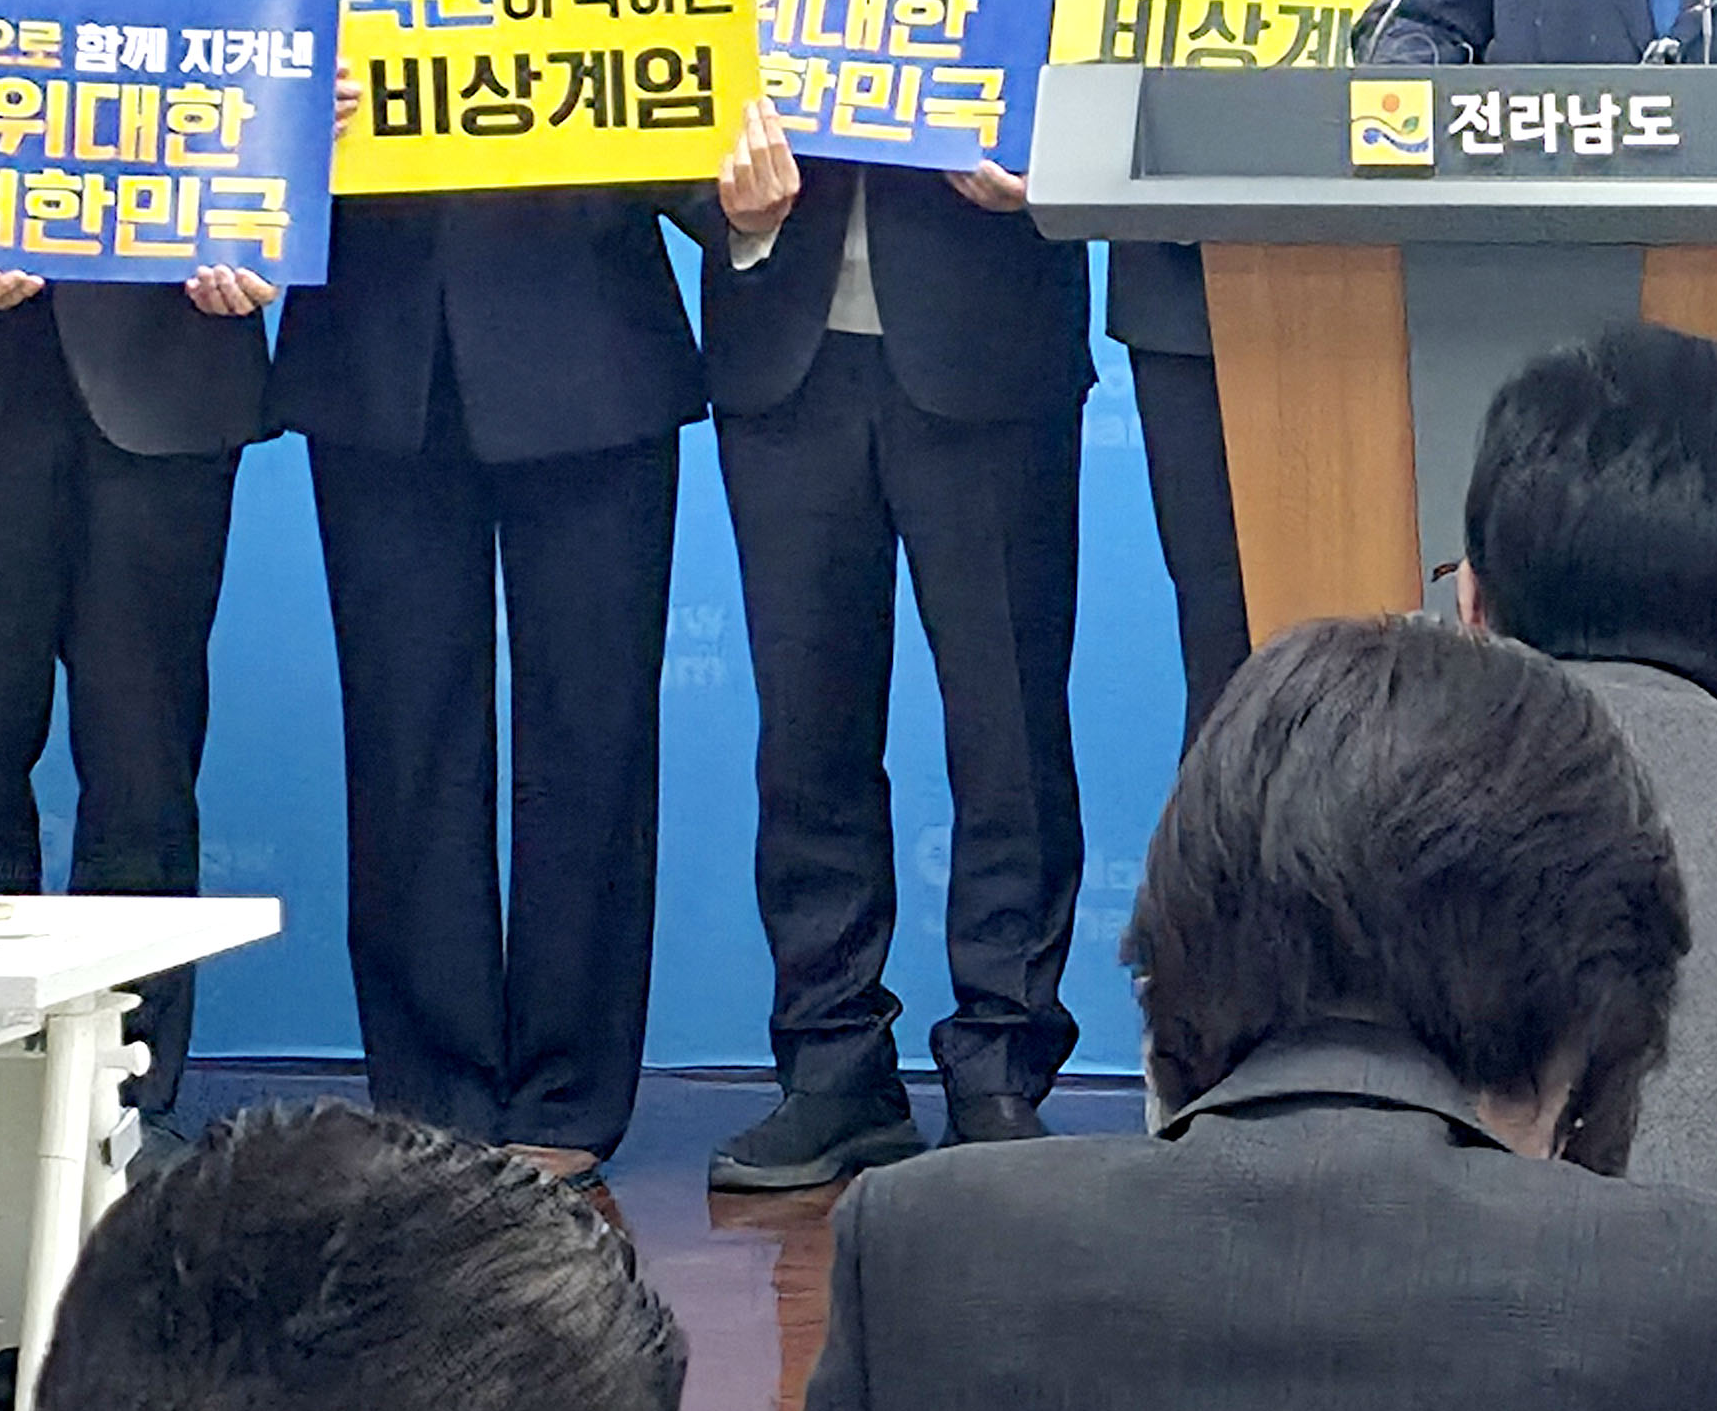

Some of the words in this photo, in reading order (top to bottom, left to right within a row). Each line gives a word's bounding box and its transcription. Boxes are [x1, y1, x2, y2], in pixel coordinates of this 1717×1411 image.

[75, 22, 167, 73] 함께
[180, 27, 315, 78] 지켜낸
[369, 46, 715, 138] 비상계엄
[760, 50, 1006, 148] 한민국
[1448, 90, 1680, 156] 전라남도
